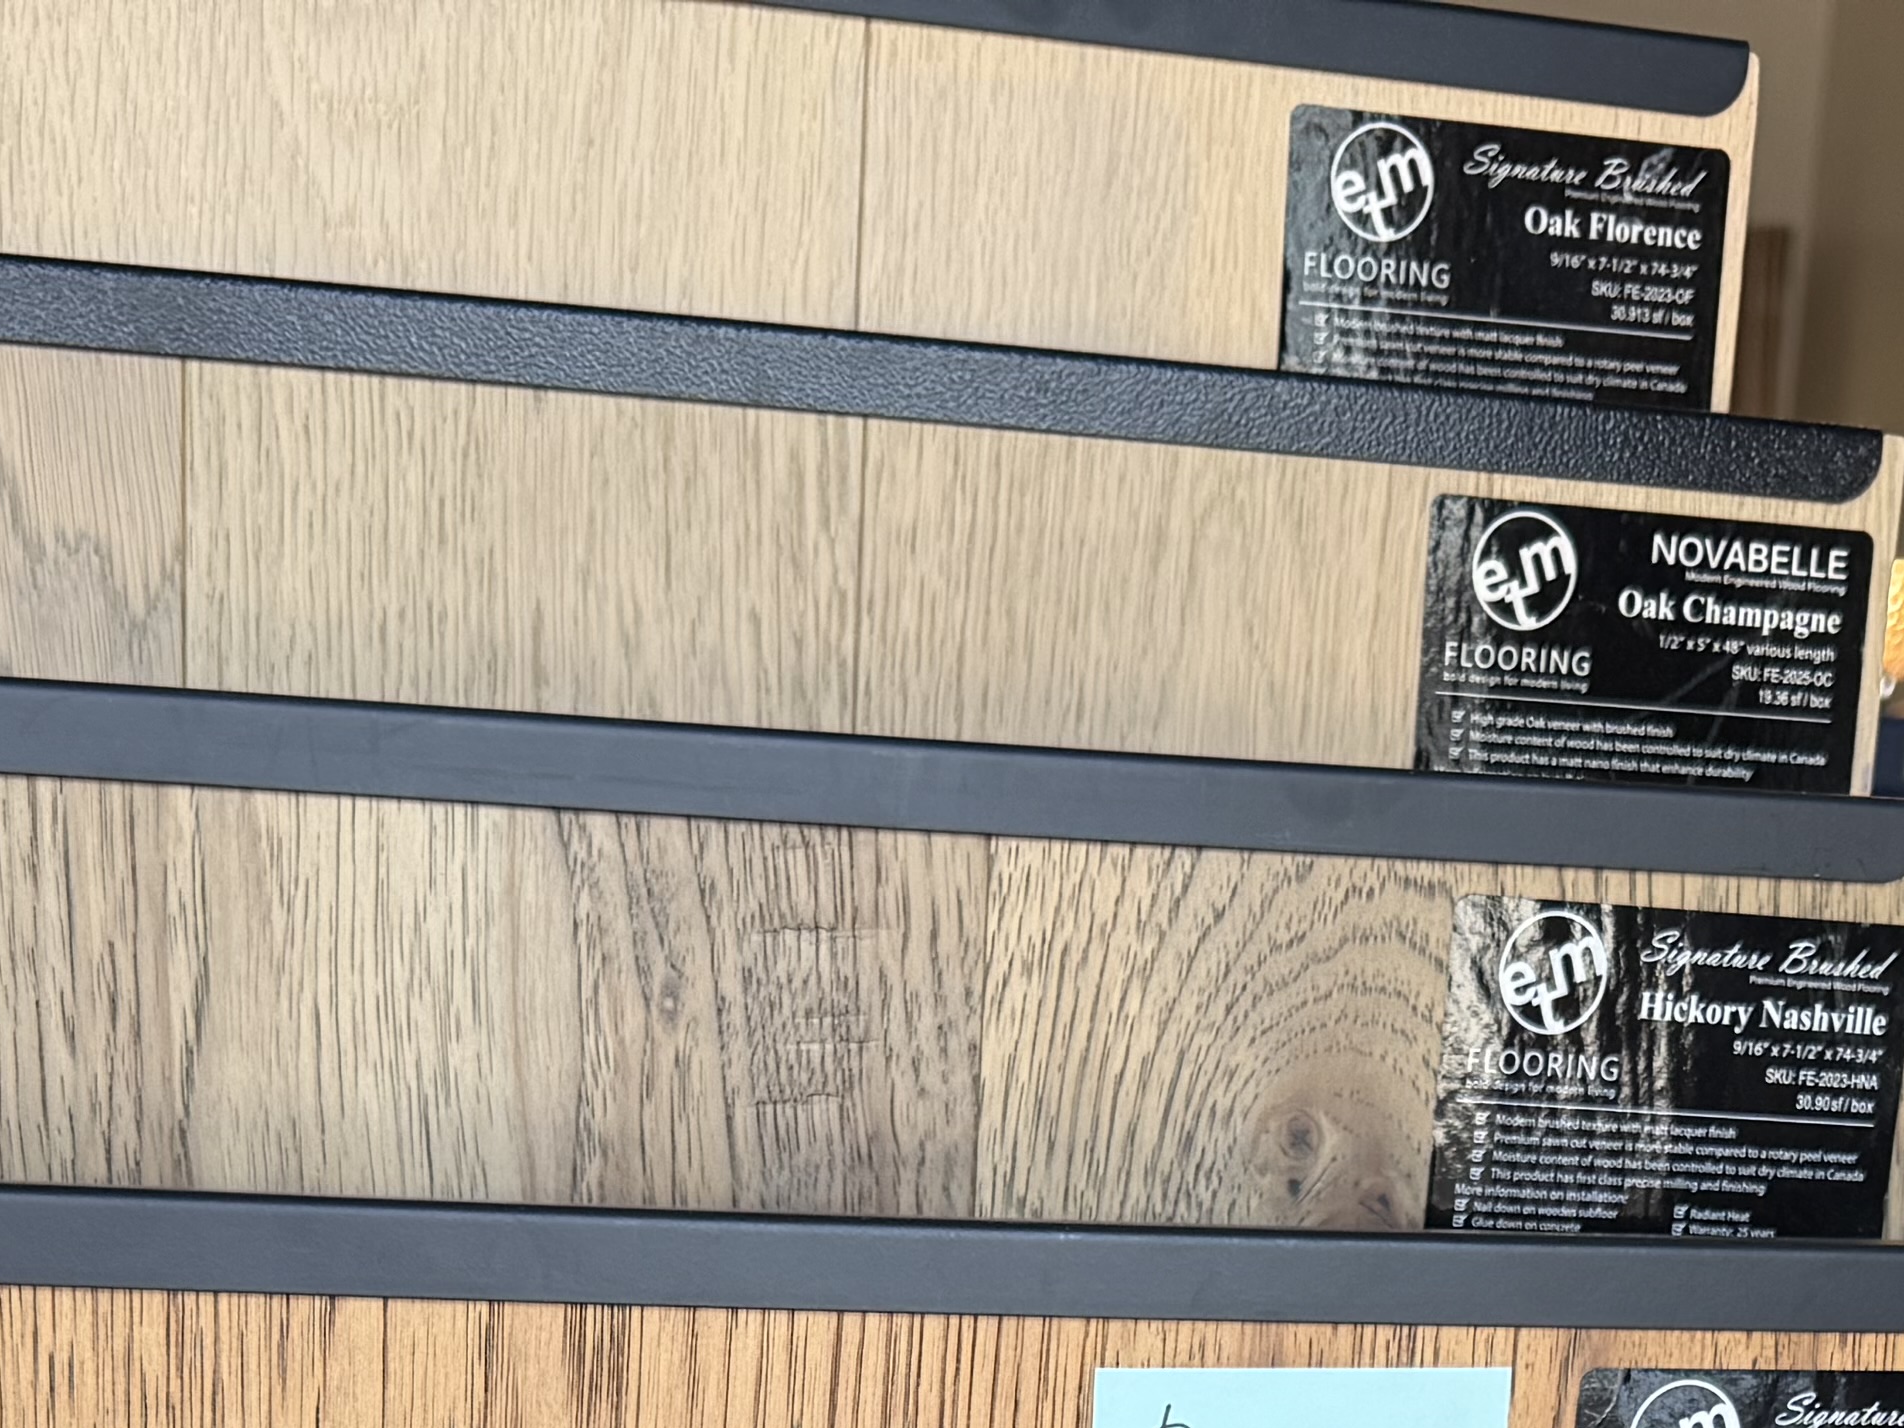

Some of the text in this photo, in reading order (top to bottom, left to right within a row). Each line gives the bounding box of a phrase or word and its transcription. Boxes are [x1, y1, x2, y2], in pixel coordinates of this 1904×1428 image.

[1462, 143, 1707, 197] Signature Brushed
[1523, 205, 1702, 250] Oak Florence
[1302, 248, 1450, 289] FLOORING
[1650, 532, 1849, 580] NOVABELLE
[1617, 588, 1842, 639] Oak Champagne
[1443, 639, 1591, 677] FLOORING
[1638, 929, 1898, 980] Signature Brushed
[1636, 989, 1887, 1036] Hickory Nashville
[1464, 1045, 1619, 1083] FLOORING
[1764, 1067, 1878, 1090] SKU: FE-2023-HNA
